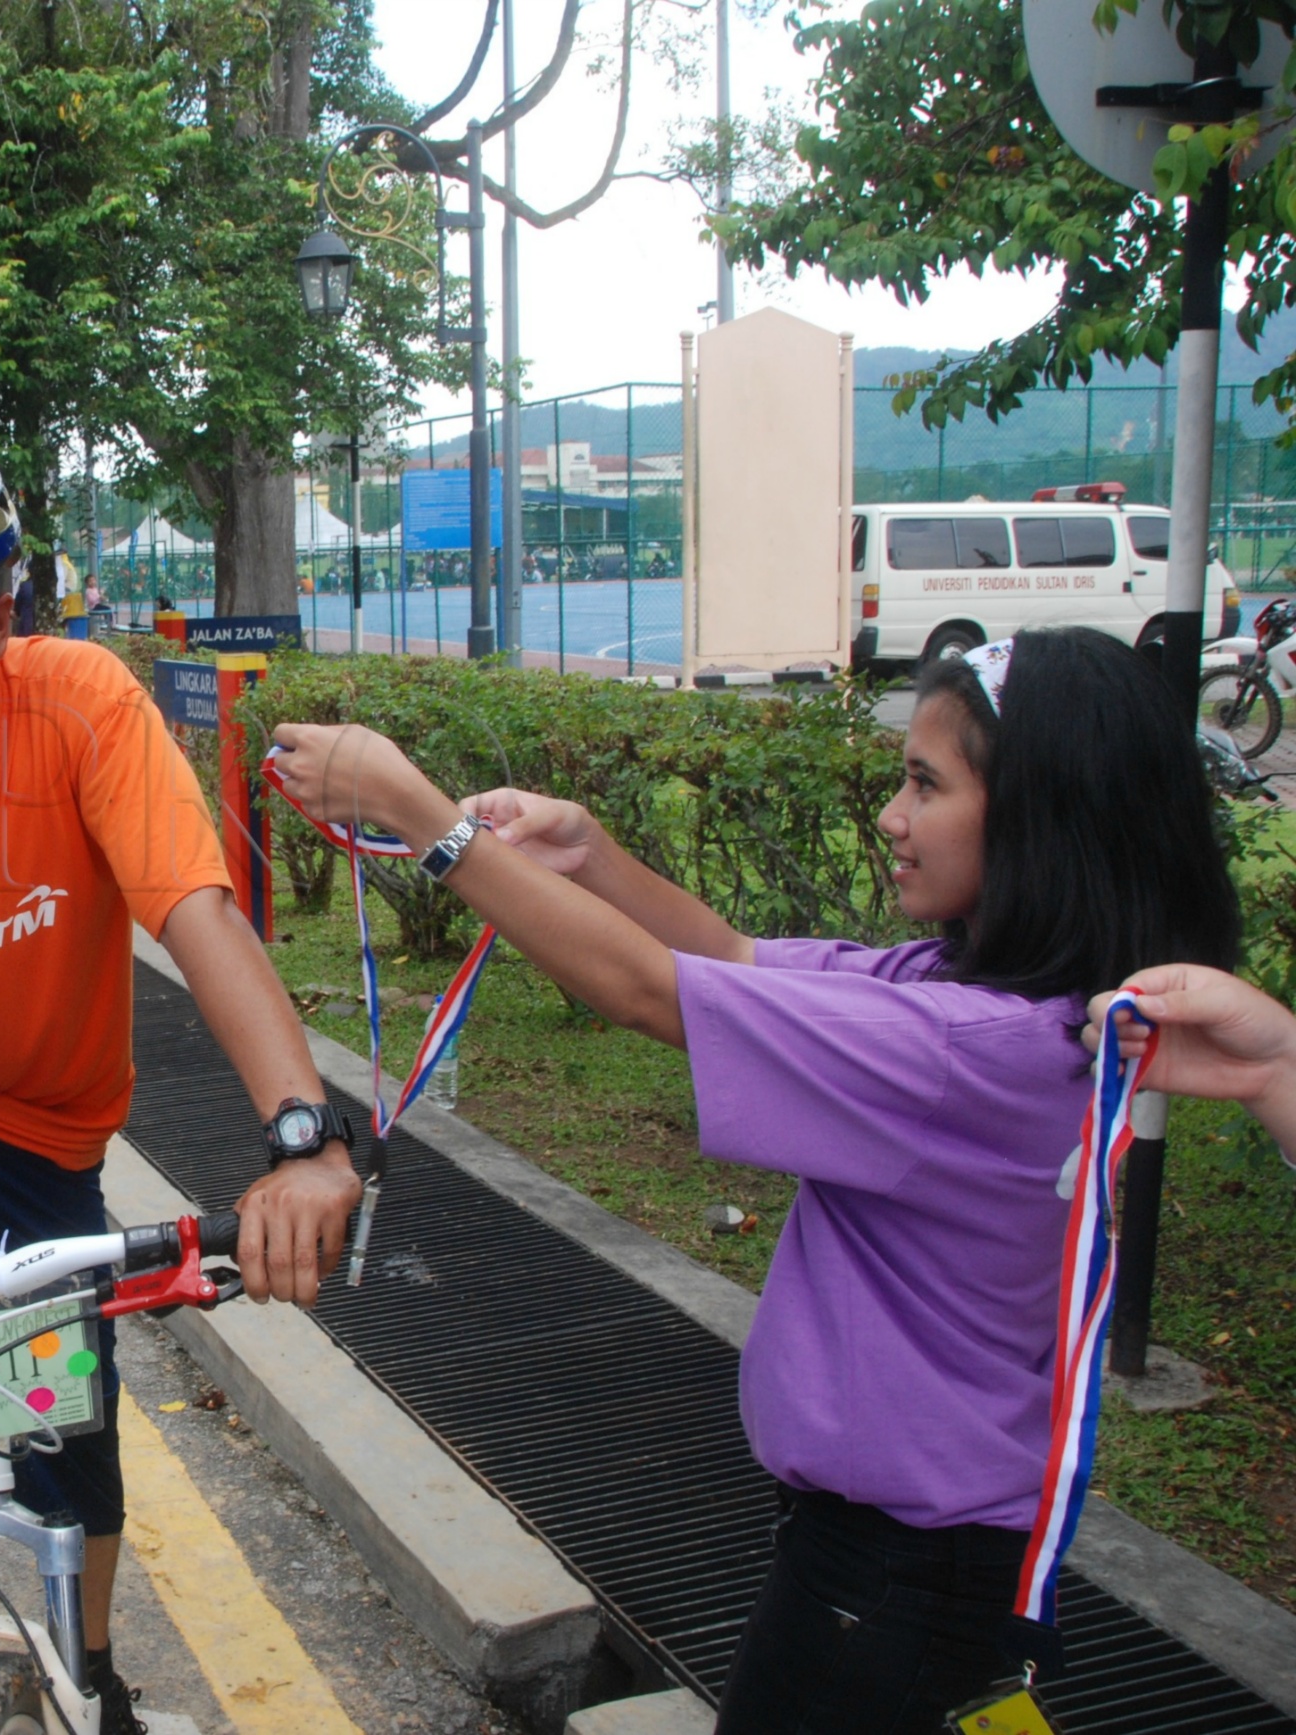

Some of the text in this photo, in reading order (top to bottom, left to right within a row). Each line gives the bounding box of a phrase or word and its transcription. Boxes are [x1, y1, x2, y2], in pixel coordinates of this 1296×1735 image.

[923, 575, 1096, 592] UNIVERSITI PENDIDIKAN SULTAN IDRIS
[189, 626, 274, 642] JALAN ZA'BA
